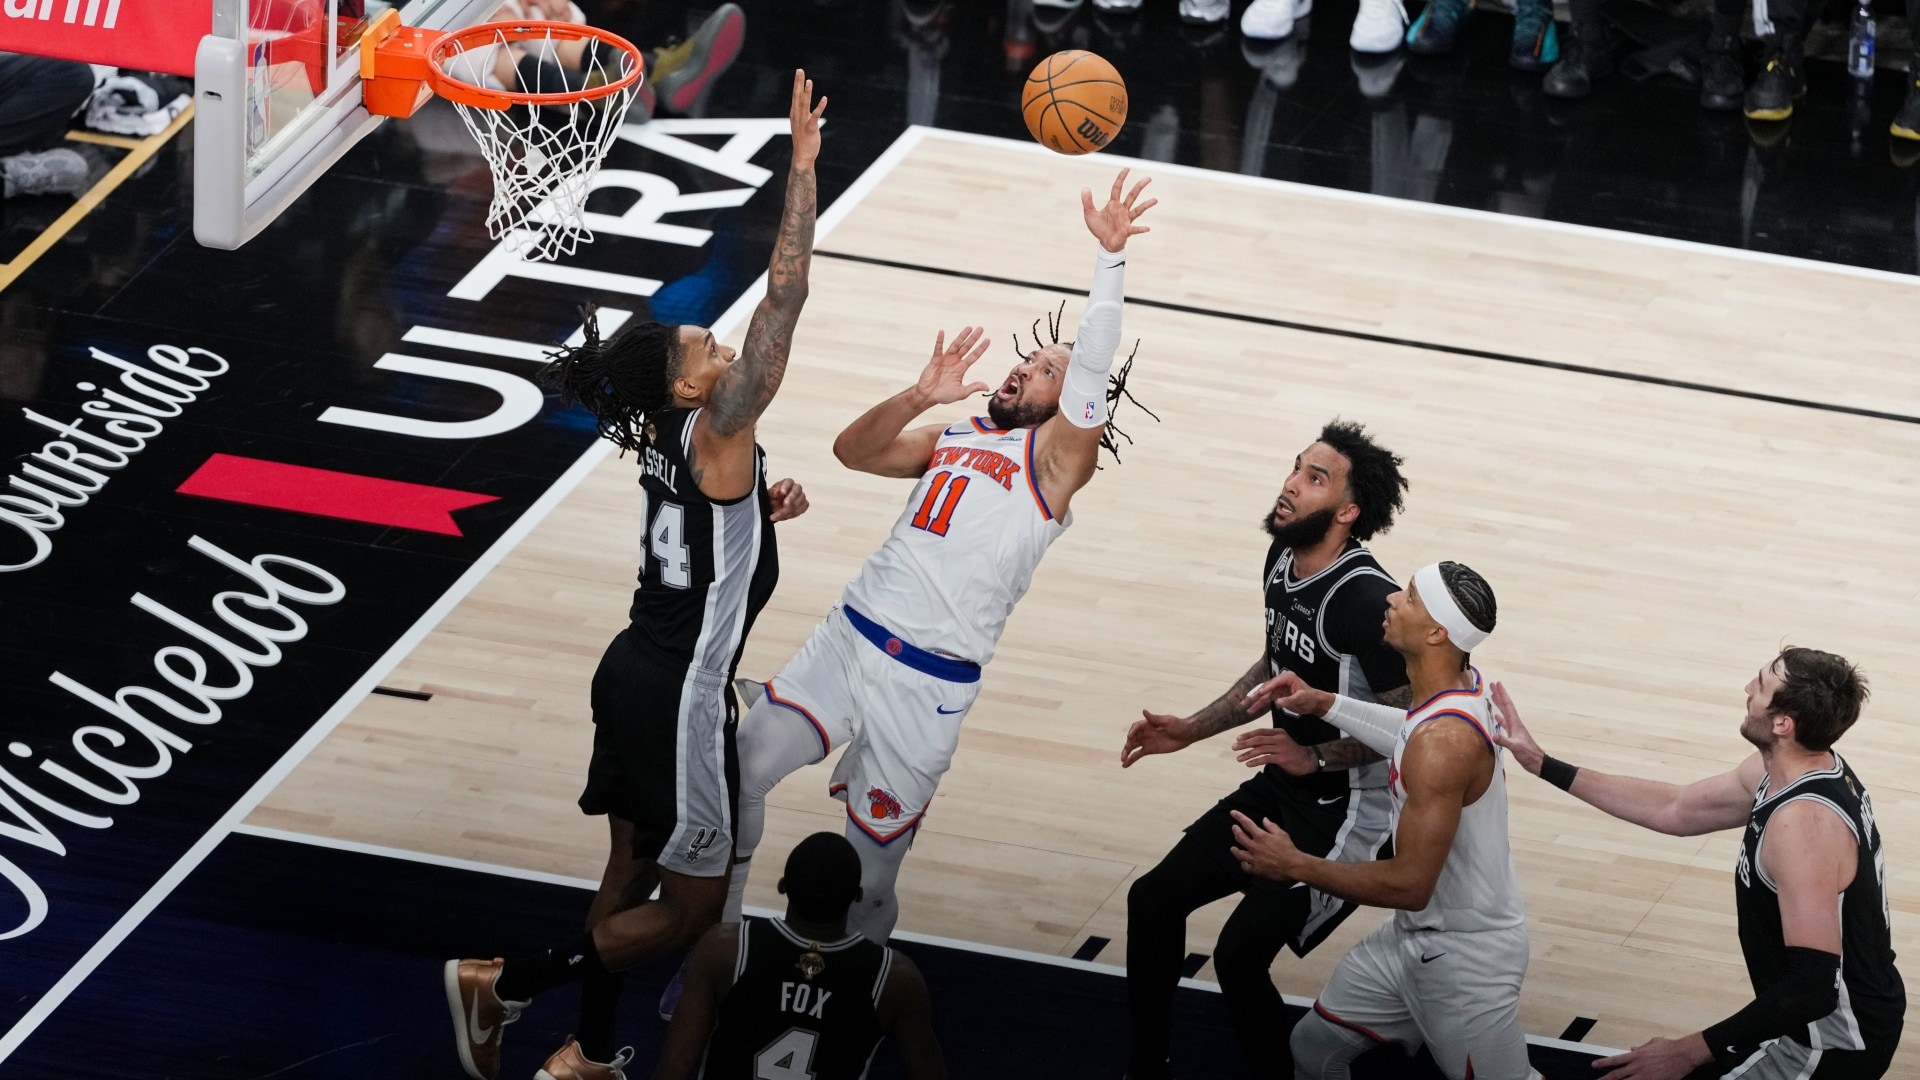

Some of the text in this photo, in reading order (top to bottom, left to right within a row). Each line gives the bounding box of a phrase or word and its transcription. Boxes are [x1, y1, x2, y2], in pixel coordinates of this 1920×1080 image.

[317, 117, 826, 439] ULTRA
[961, 448, 1021, 492] YORK
[910, 470, 971, 538] 11
[780, 981, 833, 1020] FOX
[752, 1026, 821, 1080] 4
